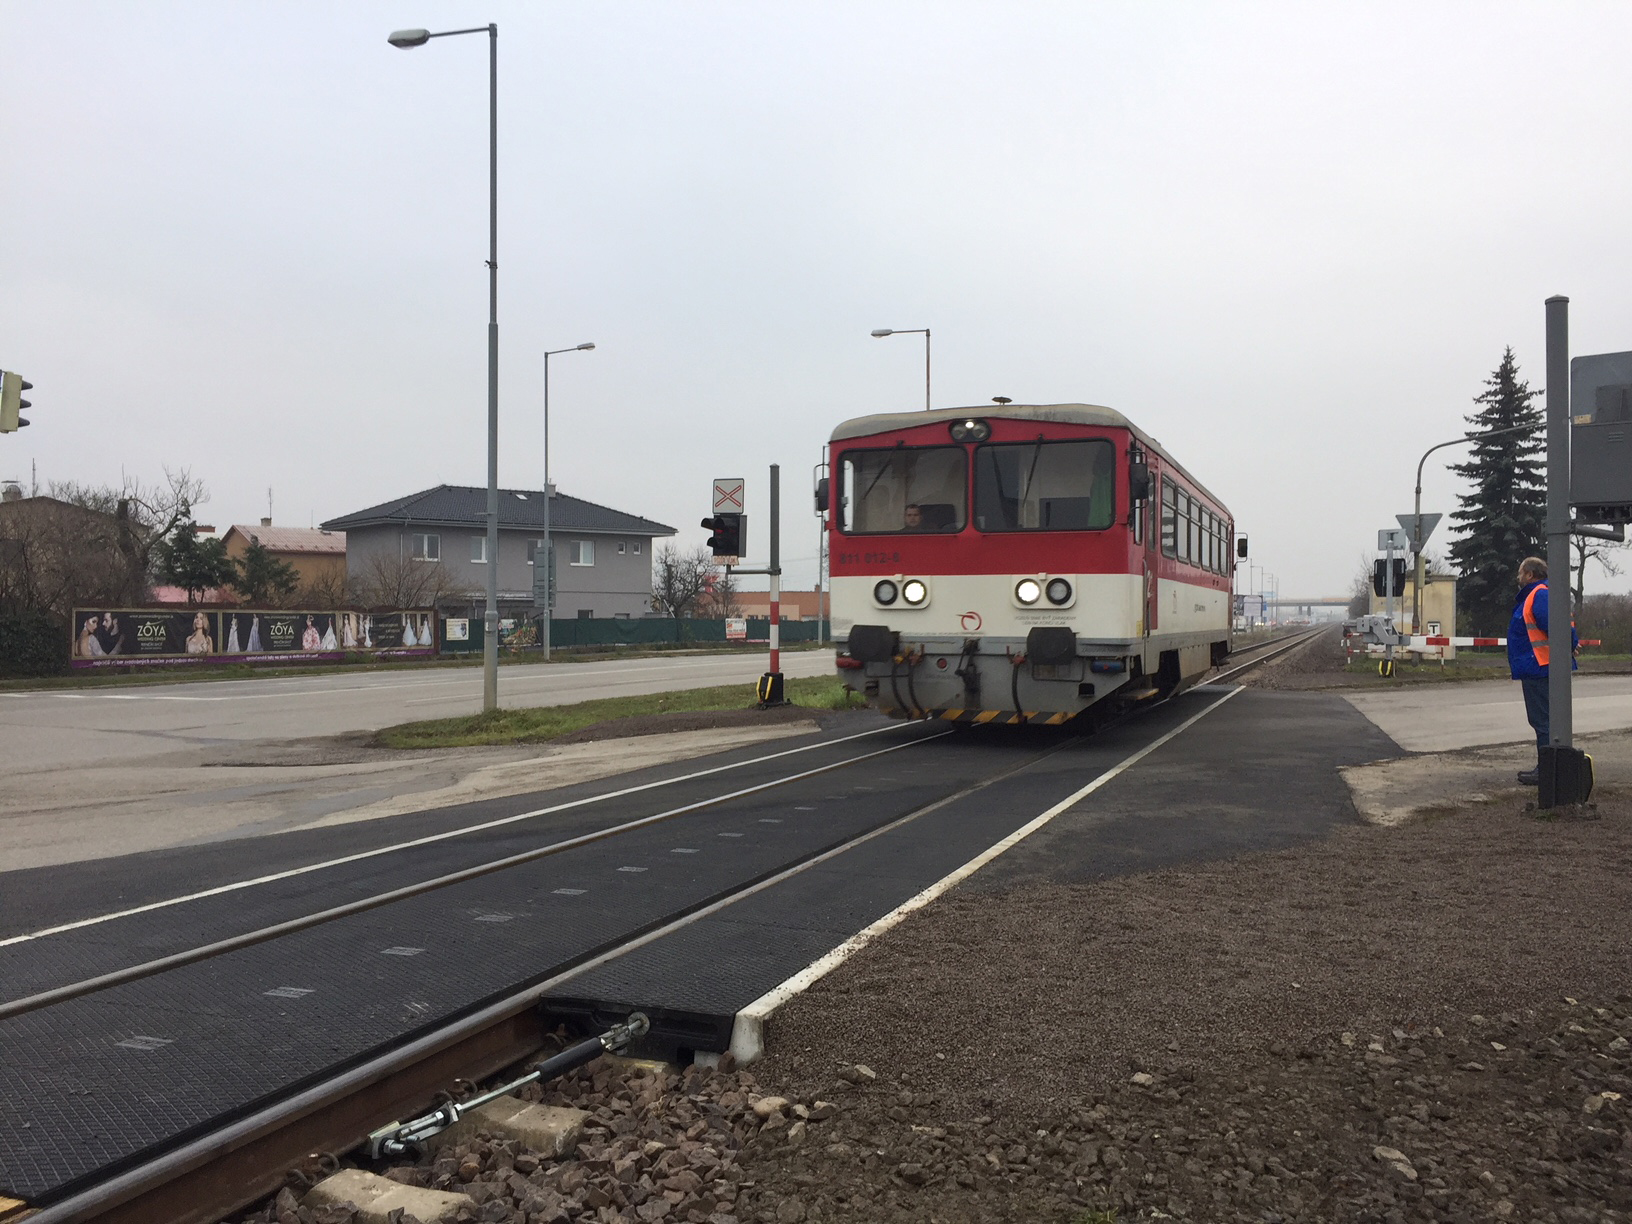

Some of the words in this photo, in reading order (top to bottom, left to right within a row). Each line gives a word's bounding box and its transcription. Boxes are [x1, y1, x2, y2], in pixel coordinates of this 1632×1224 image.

[137, 625, 167, 637] ZOYA
[270, 625, 295, 635] ZOYA
[1429, 624, 1439, 634] T
